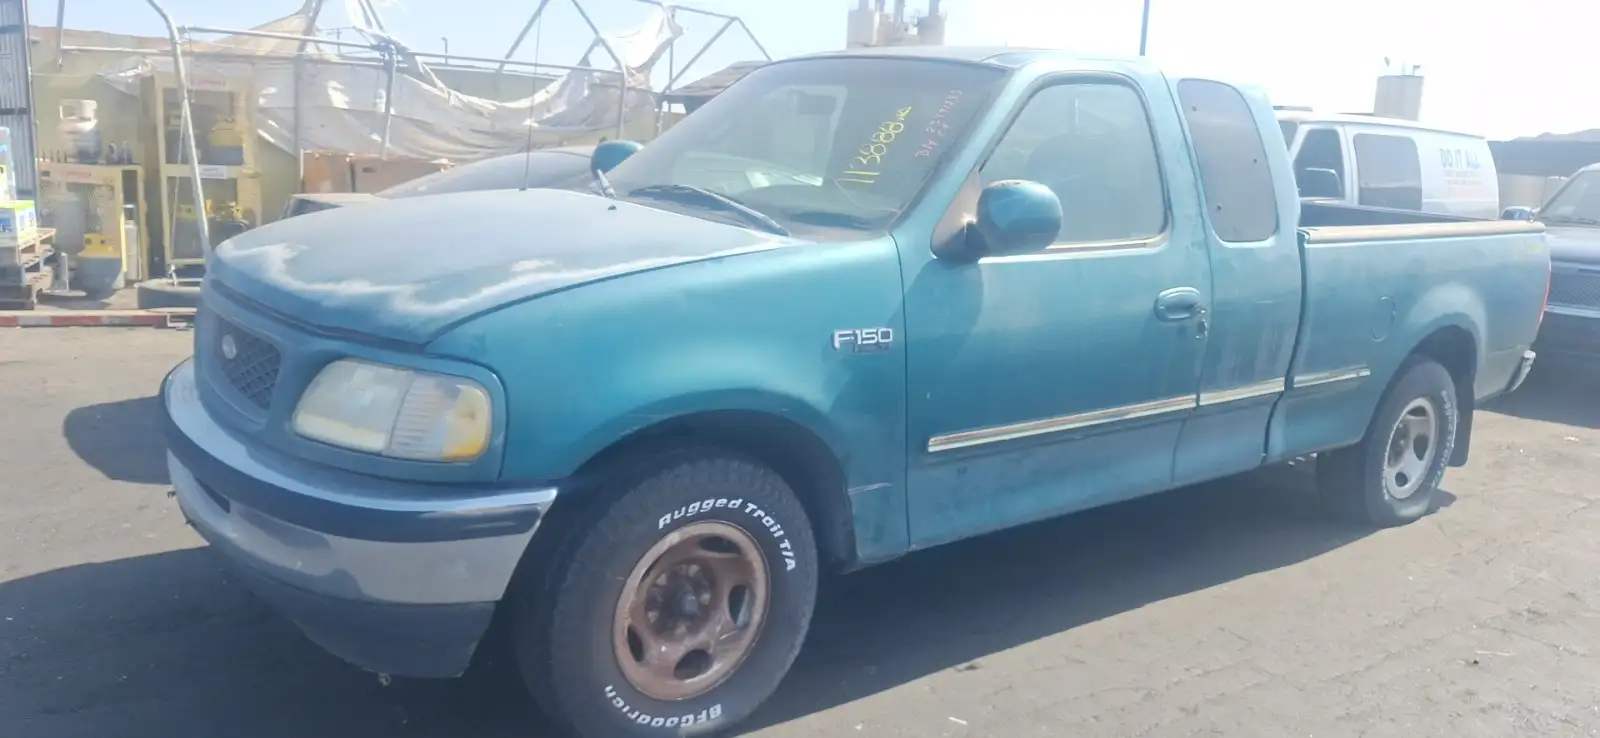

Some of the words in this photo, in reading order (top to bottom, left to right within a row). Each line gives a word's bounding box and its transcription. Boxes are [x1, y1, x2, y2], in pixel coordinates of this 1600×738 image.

[1439, 147, 1453, 169] DO
[658, 498, 743, 530] Rugged
[745, 502, 785, 539] Trail
[779, 538, 797, 572] T/A
[604, 685, 722, 727] BFGoodrich
